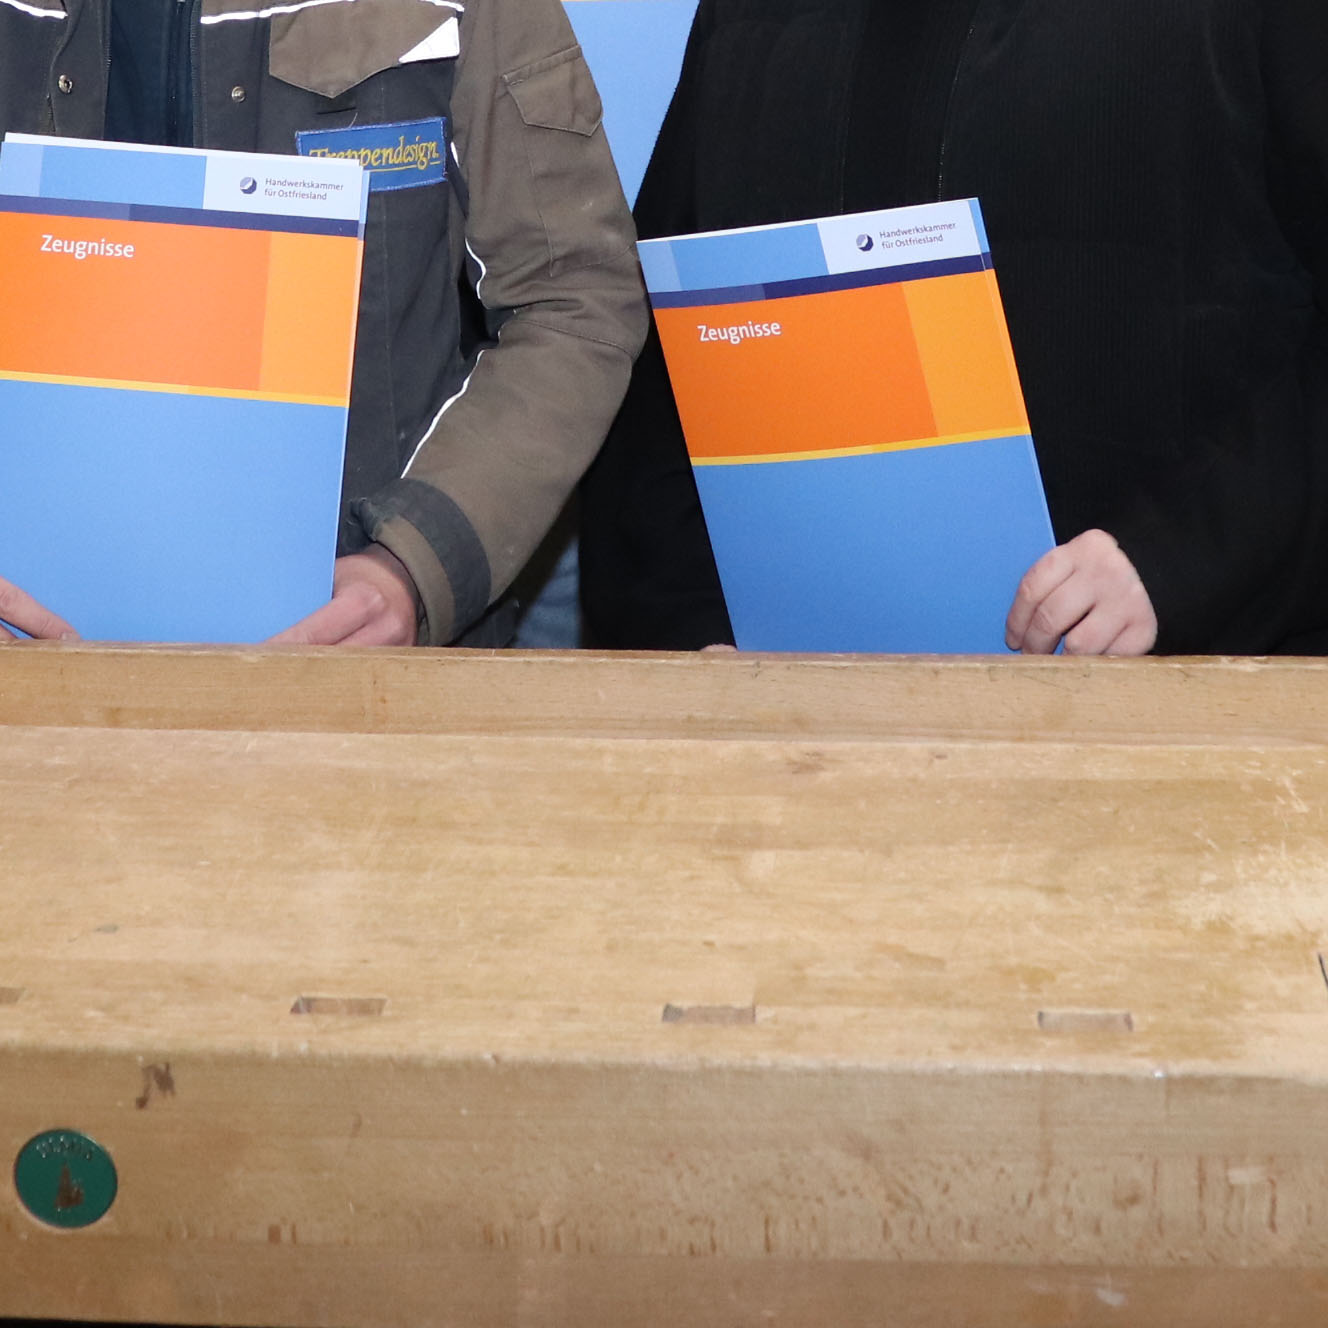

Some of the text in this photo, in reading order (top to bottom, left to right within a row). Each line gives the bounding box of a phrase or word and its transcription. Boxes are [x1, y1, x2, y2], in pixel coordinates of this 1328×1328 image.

[265, 177, 344, 191] Handwerkskammer
[264, 188, 328, 201] für Ostfriesland
[879, 222, 957, 239] Handwerkskammer
[40, 234, 135, 259] Zeugnisse
[881, 234, 945, 249] für Ostfriesland
[697, 320, 783, 345] Zeugnisse
